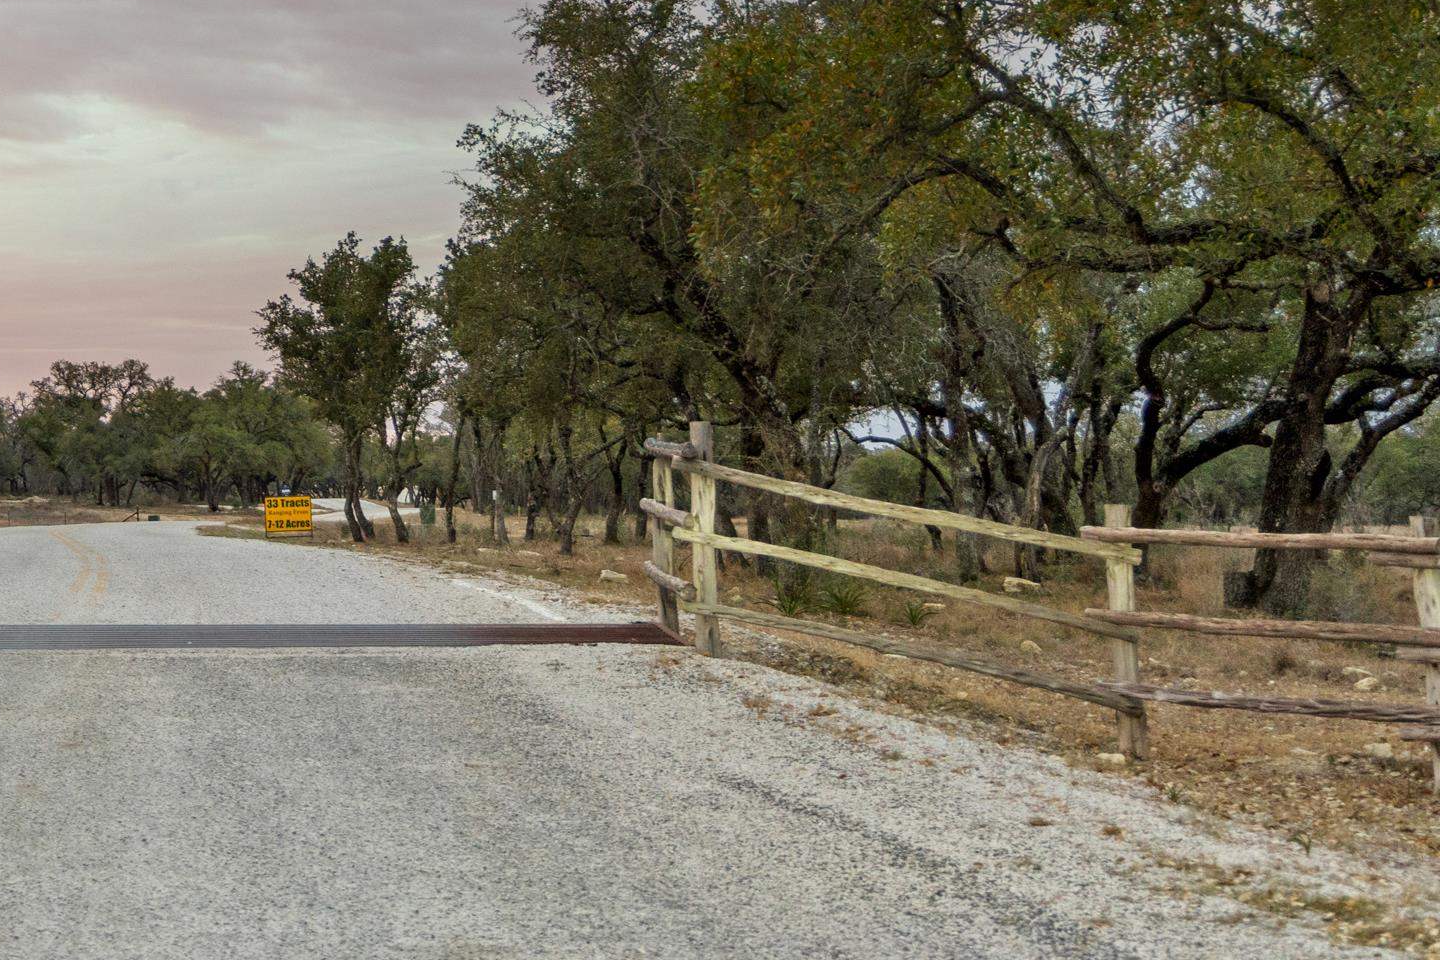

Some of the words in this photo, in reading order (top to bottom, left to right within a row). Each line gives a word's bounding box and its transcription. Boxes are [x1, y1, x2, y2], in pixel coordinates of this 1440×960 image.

[266, 499, 278, 508] 33
[280, 499, 310, 508] Tracts
[267, 520, 284, 528] 7-12
[285, 520, 311, 528] Acres
